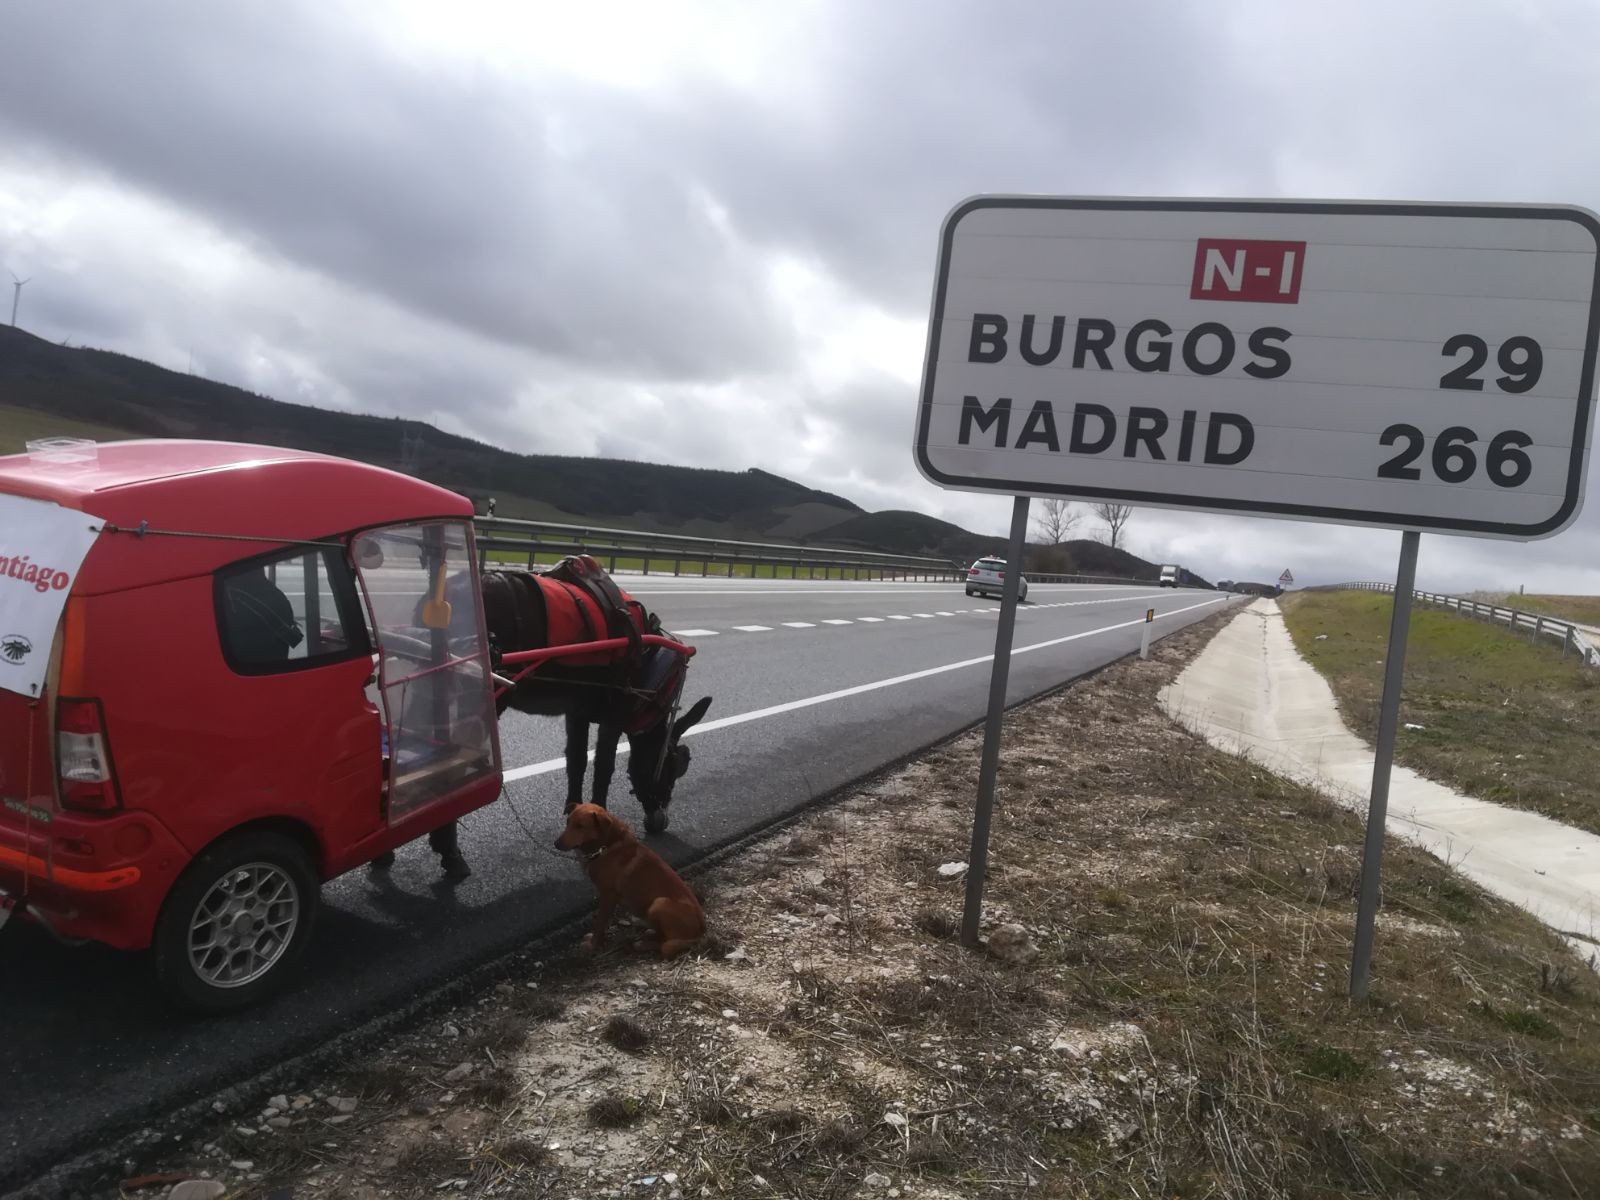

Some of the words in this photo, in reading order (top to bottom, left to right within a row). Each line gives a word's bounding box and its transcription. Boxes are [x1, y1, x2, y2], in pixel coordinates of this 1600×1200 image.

[967, 313, 1293, 379] BURGOS
[1440, 334, 1543, 394] 29
[957, 396, 1255, 465] MADRID
[1377, 424, 1534, 488] 266
